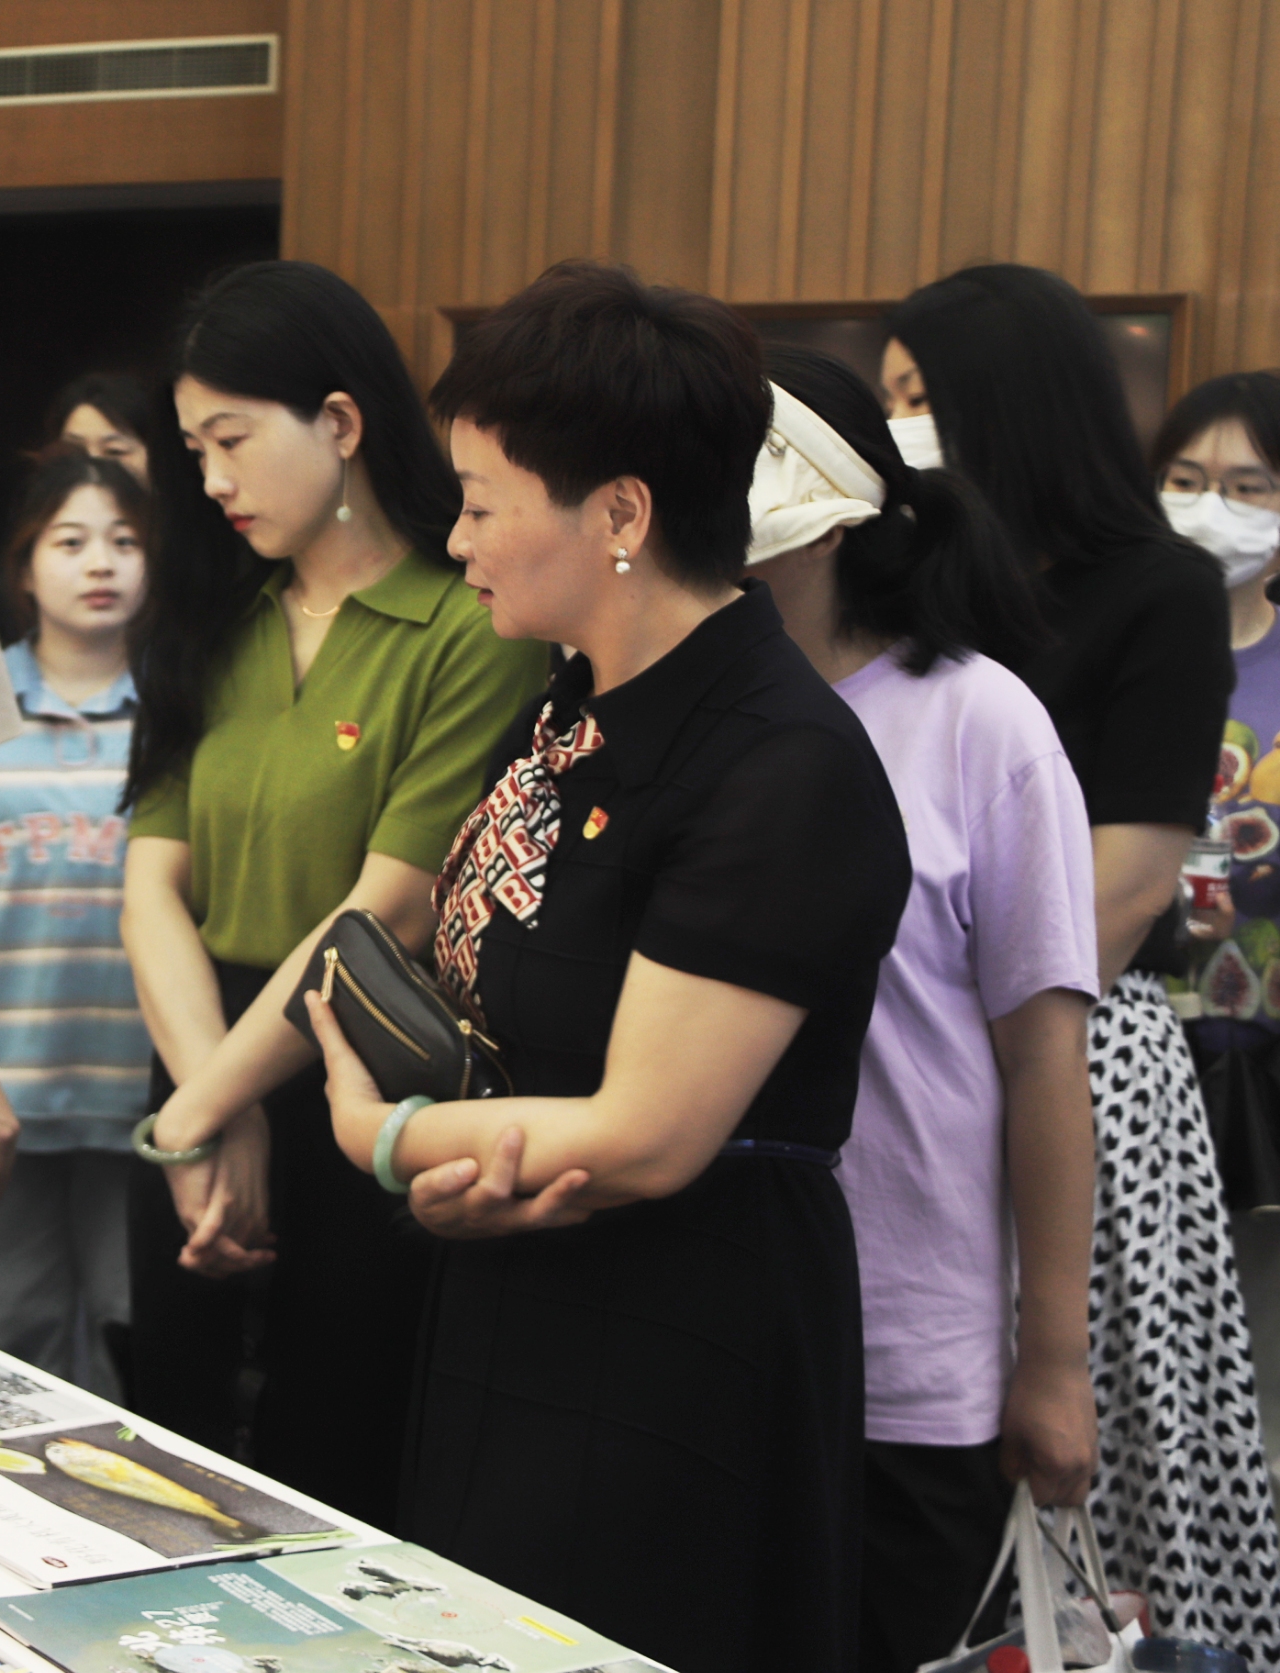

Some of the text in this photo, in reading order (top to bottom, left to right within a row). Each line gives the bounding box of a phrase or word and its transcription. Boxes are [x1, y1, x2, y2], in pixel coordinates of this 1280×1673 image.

[477, 830, 499, 864] B
[506, 828, 539, 866] B
[463, 889, 490, 927] B
[495, 879, 530, 914] B
